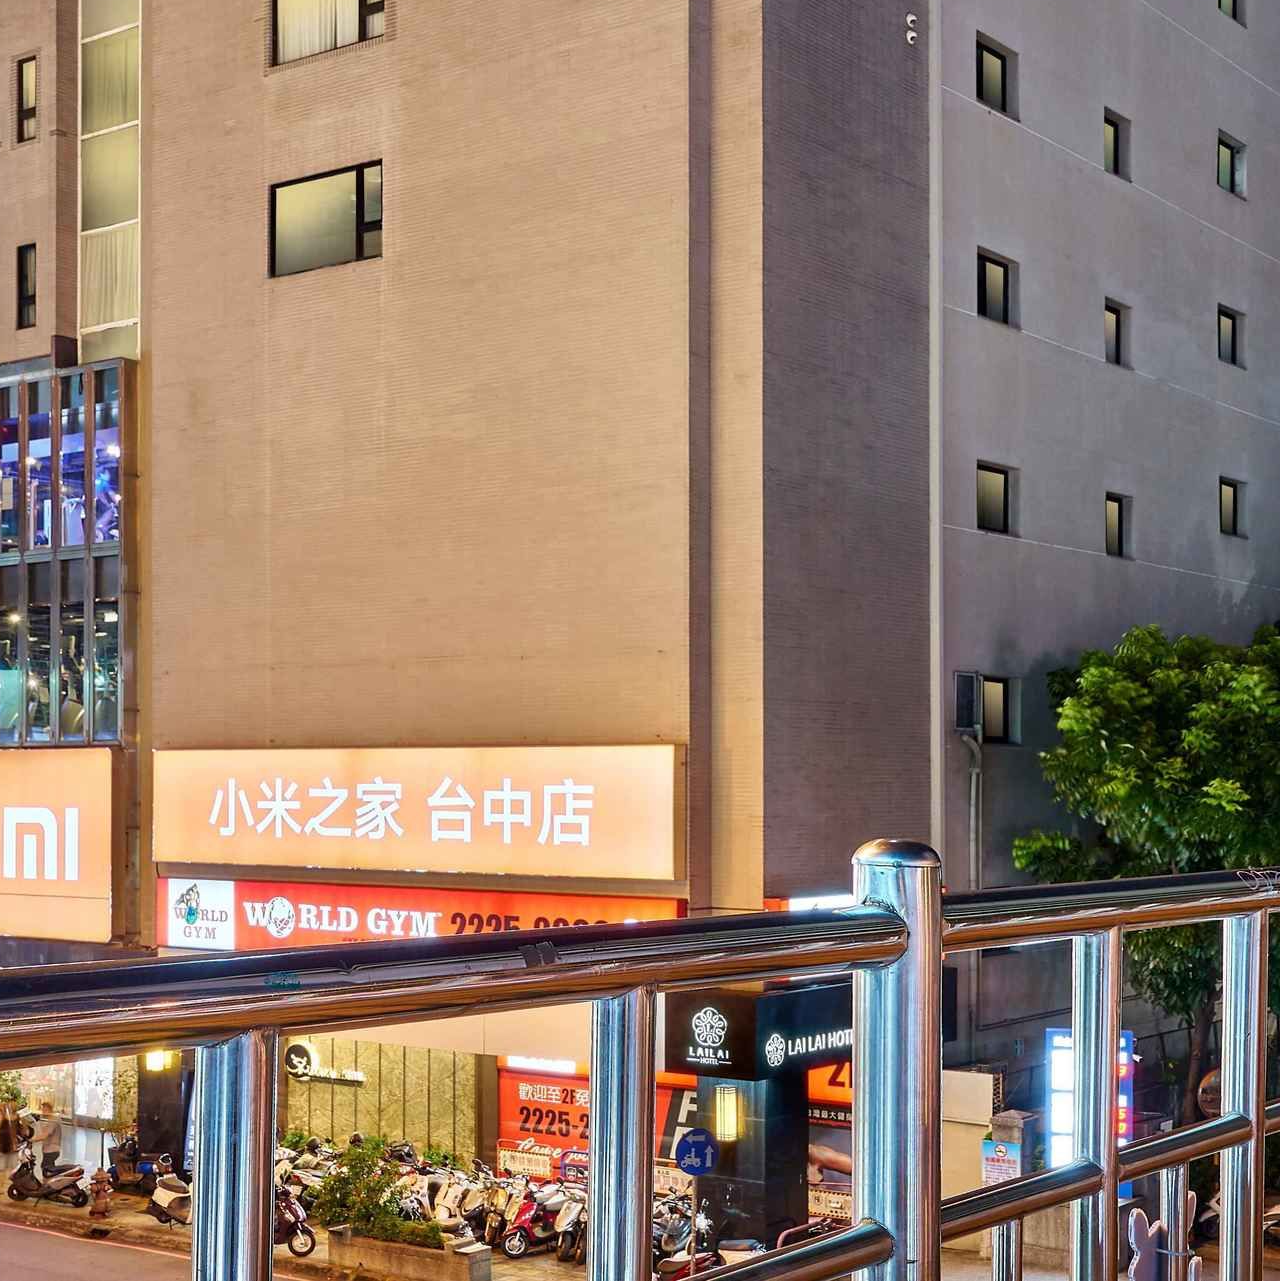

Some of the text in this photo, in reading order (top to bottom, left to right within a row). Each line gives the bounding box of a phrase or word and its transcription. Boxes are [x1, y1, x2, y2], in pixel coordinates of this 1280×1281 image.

[208, 776, 596, 847] 小米之家 台中店
[174, 906, 228, 924] WORLD
[242, 897, 359, 939] WORLD
[367, 908, 437, 938] GYM
[183, 927, 216, 939] GYM
[787, 1037, 807, 1056] LAI
[808, 1033, 826, 1052] LAI
[700, 1057, 719, 1065] HOTEL
